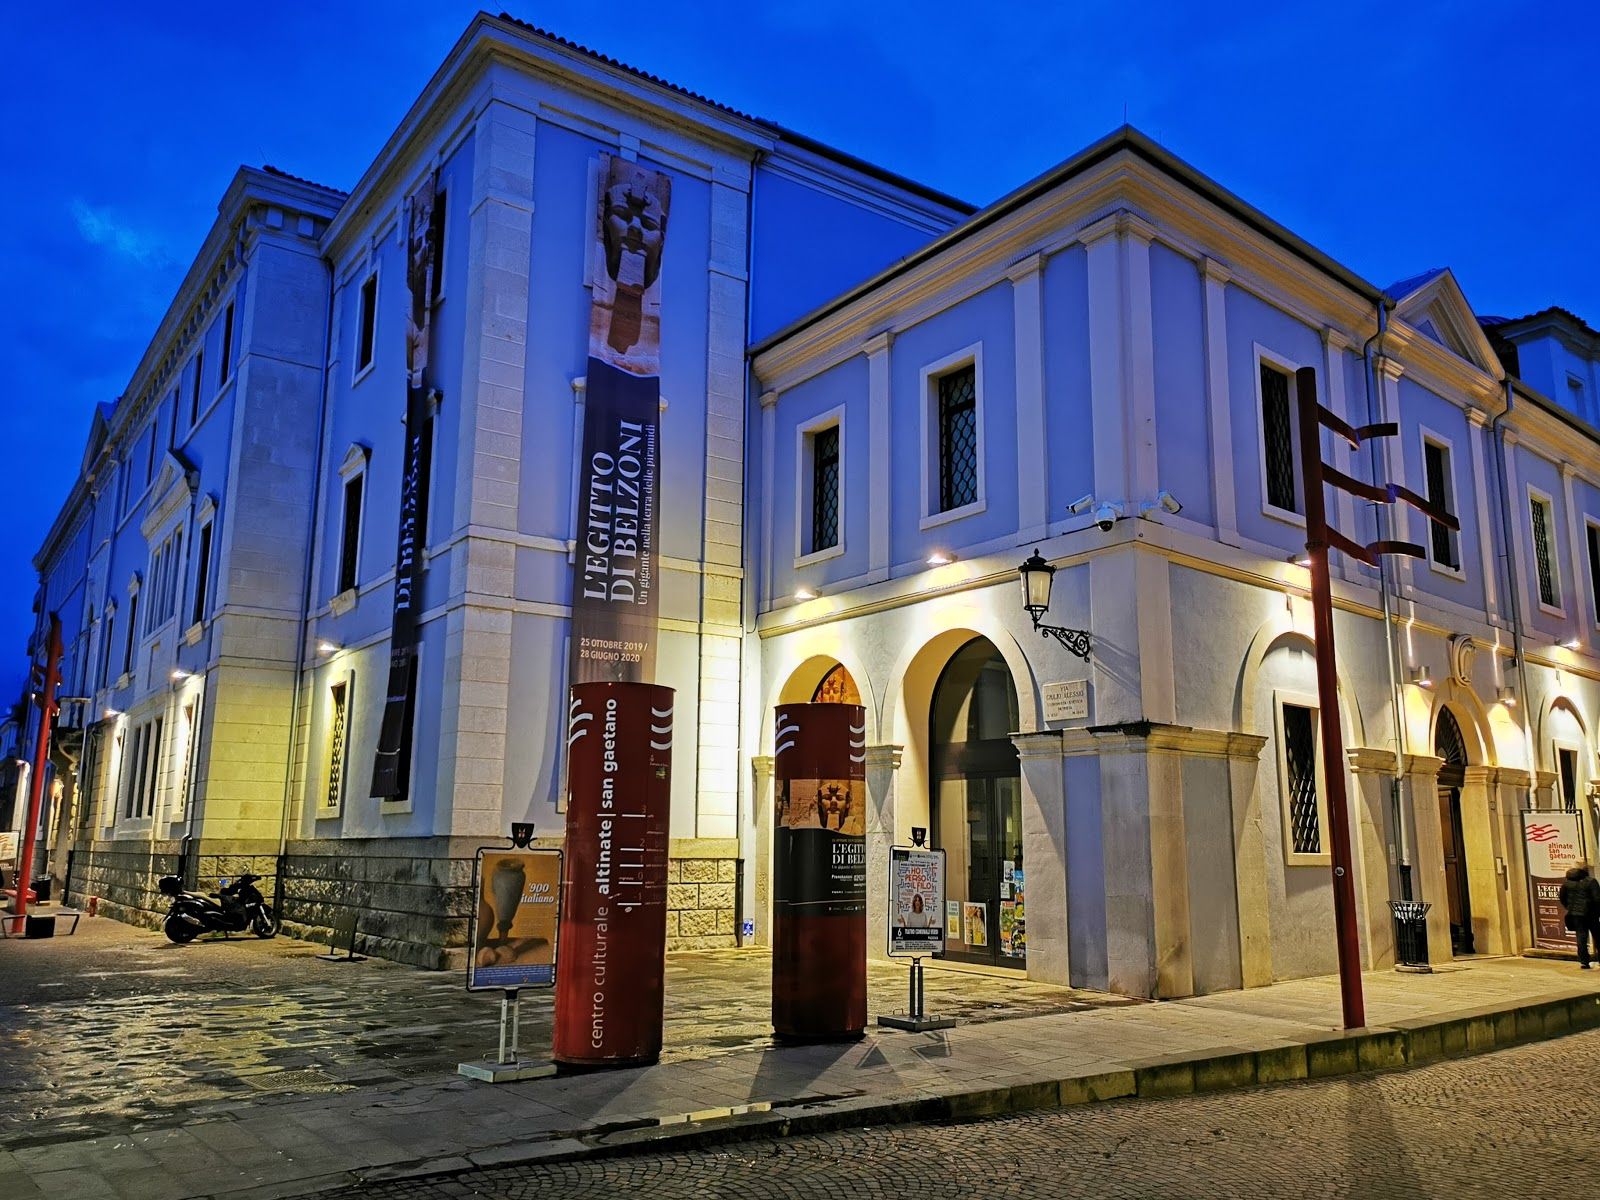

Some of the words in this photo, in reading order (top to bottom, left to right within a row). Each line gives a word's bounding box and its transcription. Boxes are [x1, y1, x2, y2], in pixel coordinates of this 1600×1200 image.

[644, 424, 655, 467] piramidi
[613, 420, 642, 559] BELZONI
[643, 470, 653, 494] delle
[643, 496, 652, 521] terra
[584, 451, 615, 601] L'EGITTO
[641, 523, 651, 548] nella
[639, 550, 650, 589] gigante
[610, 566, 636, 604] DI
[638, 590, 648, 605] Un
[580, 637, 590, 646] 25
[591, 639, 623, 650] OTTOBRE
[624, 641, 643, 651] 2019
[580, 649, 590, 658] 28
[590, 650, 619, 661] GIUGNO
[620, 653, 640, 662] 2020
[603, 699, 618, 772] gaetano
[602, 778, 614, 809] san
[640, 838, 646, 847] 2
[1548, 842, 1573, 850] altinate
[595, 820, 612, 894] altinate
[832, 854, 844, 864] DI
[1549, 853, 1576, 861] gaetano
[520, 893, 554, 903] italiano
[529, 882, 550, 893] '900
[592, 906, 608, 985] culturale
[592, 992, 605, 1048] centro
